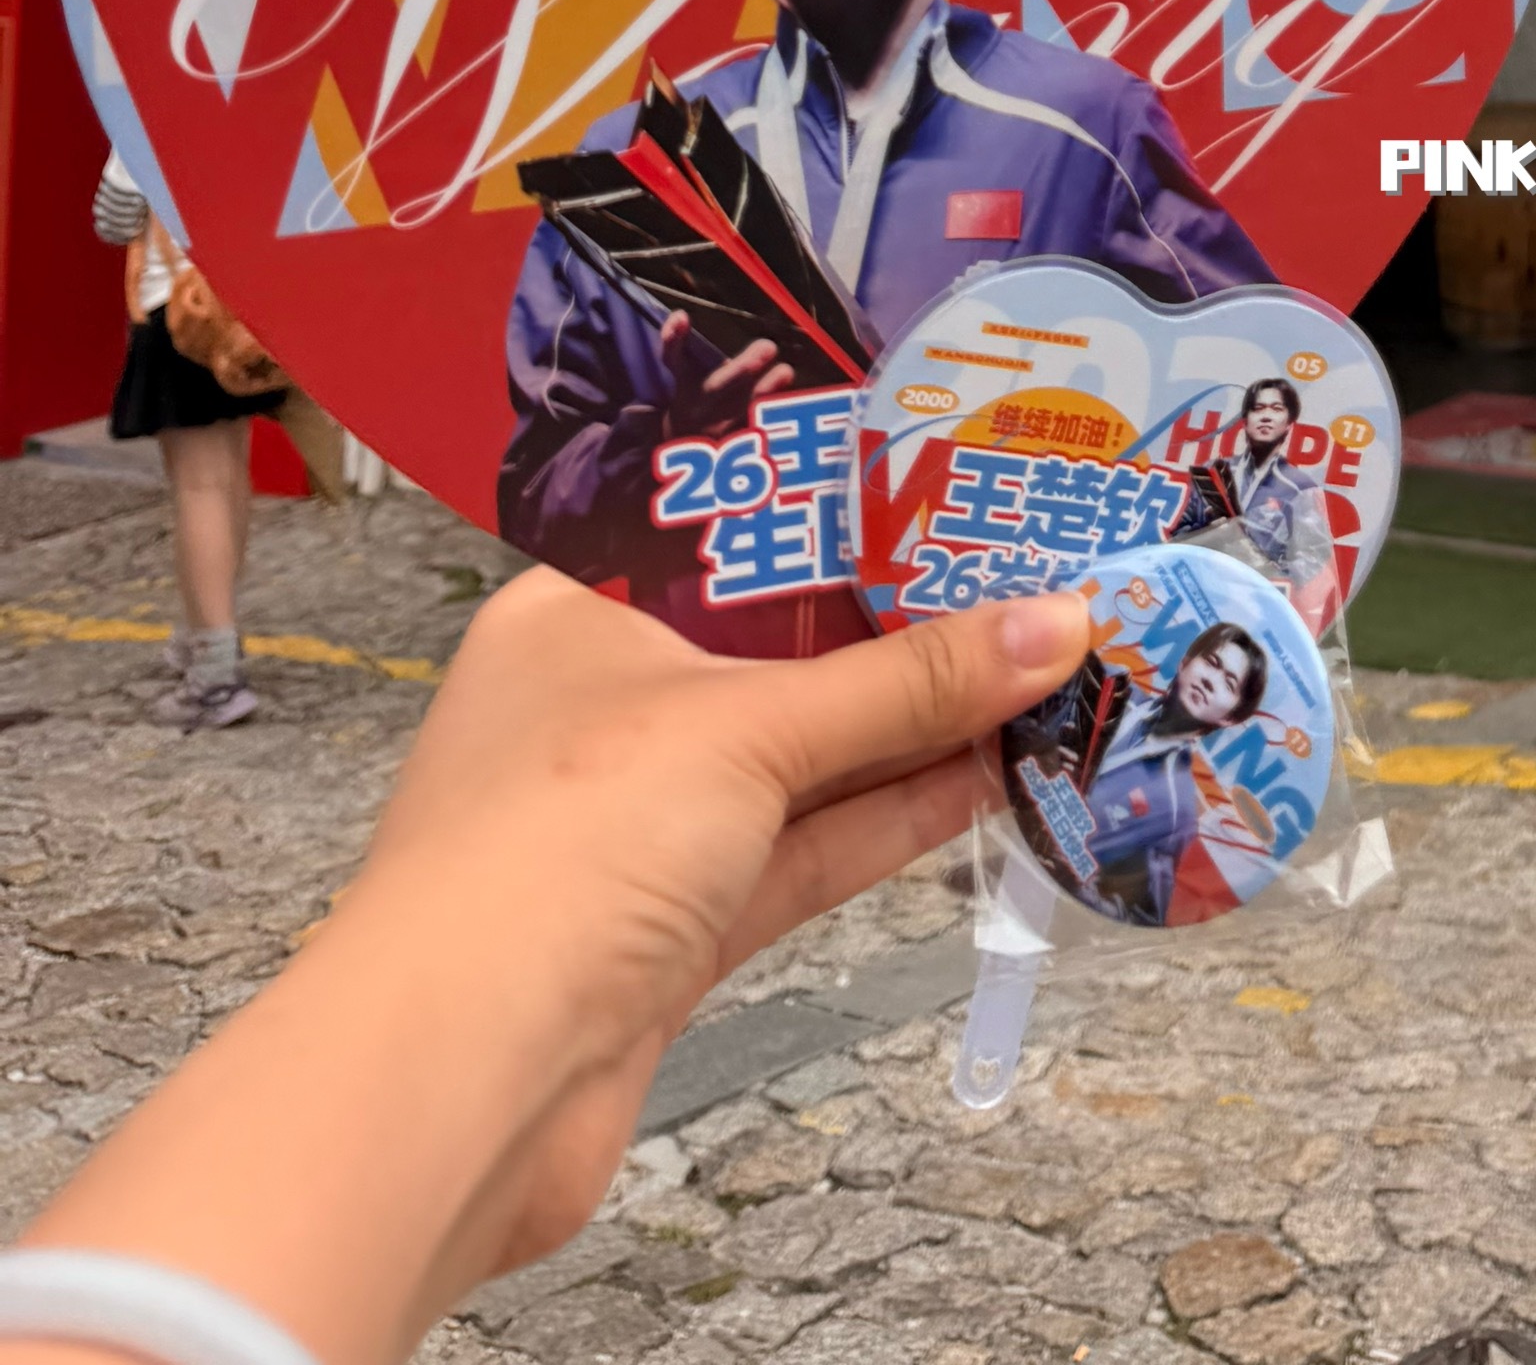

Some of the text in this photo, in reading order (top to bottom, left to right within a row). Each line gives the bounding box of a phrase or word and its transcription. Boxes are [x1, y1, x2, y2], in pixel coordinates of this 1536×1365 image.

[1292, 356, 1322, 376] 05
[901, 388, 954, 410] 2000
[1342, 419, 1367, 443] 11
[929, 445, 1190, 555] 王楚钦
[1130, 578, 1152, 605] 05
